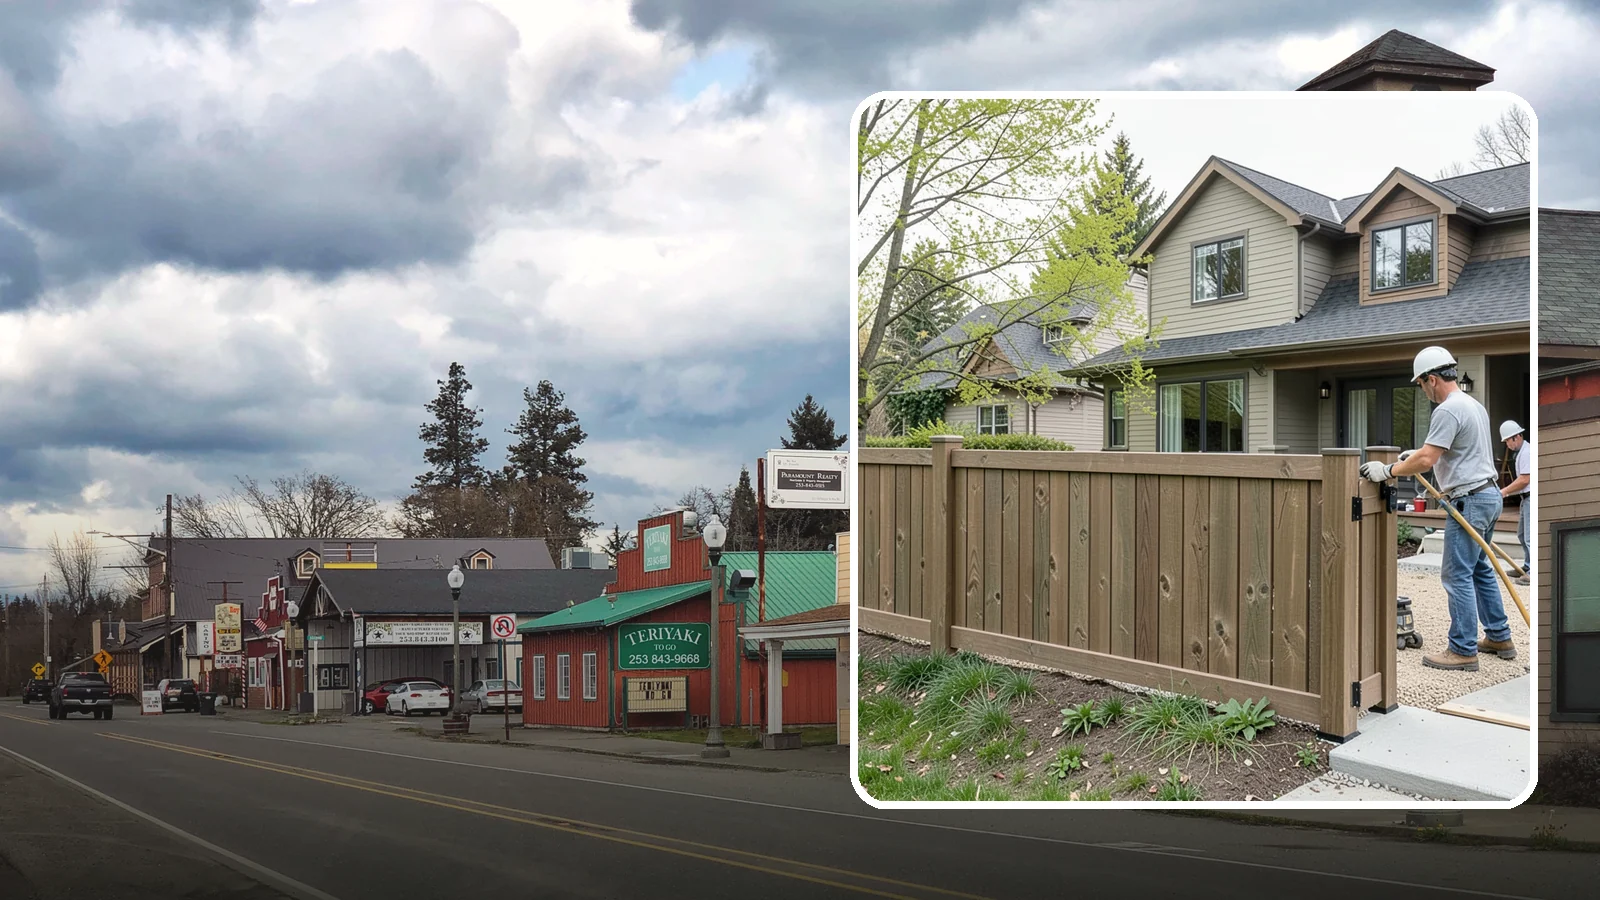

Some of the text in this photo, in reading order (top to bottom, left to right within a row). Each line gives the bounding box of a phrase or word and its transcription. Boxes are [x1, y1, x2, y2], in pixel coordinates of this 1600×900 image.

[781, 471, 839, 480] PARAMOUNT REALTY
[625, 627, 703, 646] TERIYAKI
[628, 653, 700, 664] 253 843-9668
